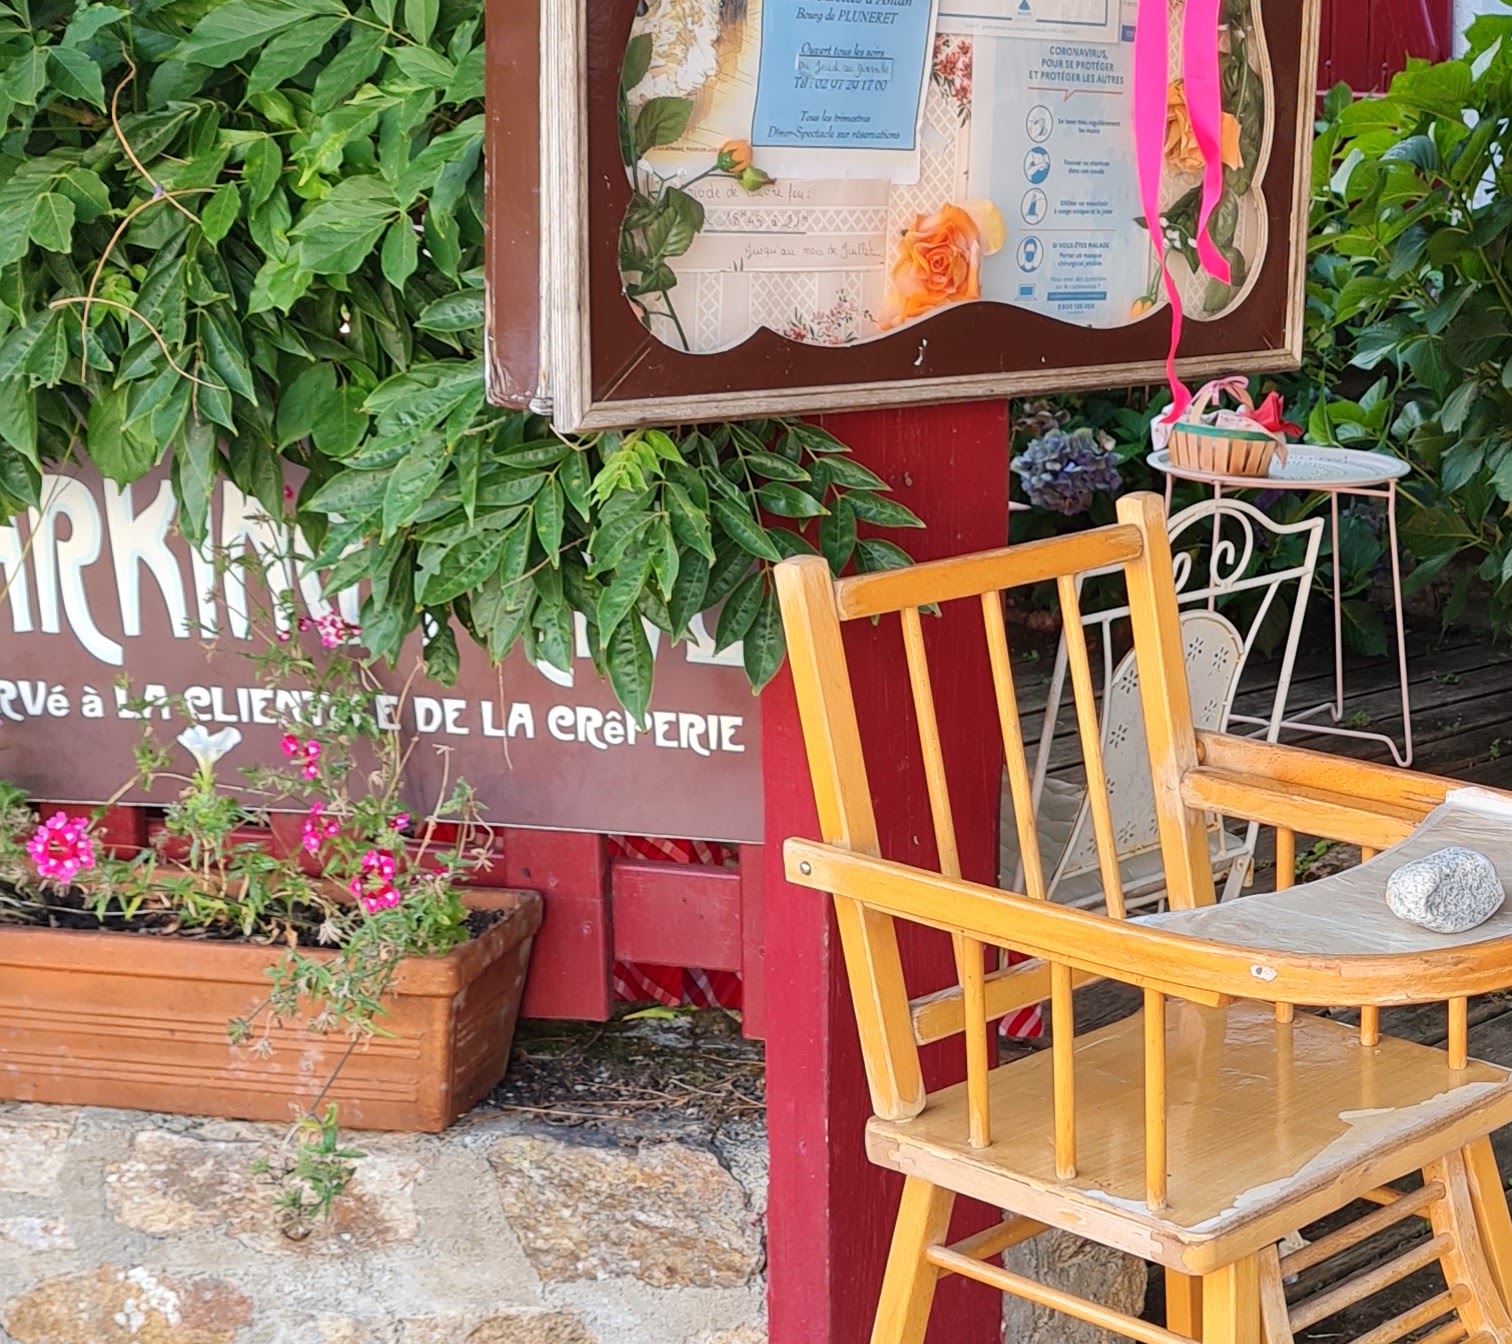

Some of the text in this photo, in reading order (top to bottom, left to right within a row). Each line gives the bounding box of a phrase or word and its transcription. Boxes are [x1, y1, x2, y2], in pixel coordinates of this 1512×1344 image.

[796, 7, 899, 25] Bourg de PLUNERET
[1049, 45, 1108, 60] CORONAVIRUS,
[1041, 58, 1114, 72] POUR SE PROTÉGER
[1029, 70, 1124, 85] ET PROTÉGER LES AUTRES
[81, 684, 105, 719] à
[113, 683, 173, 721] LA
[413, 696, 471, 736] DE
[480, 700, 535, 739] LA
